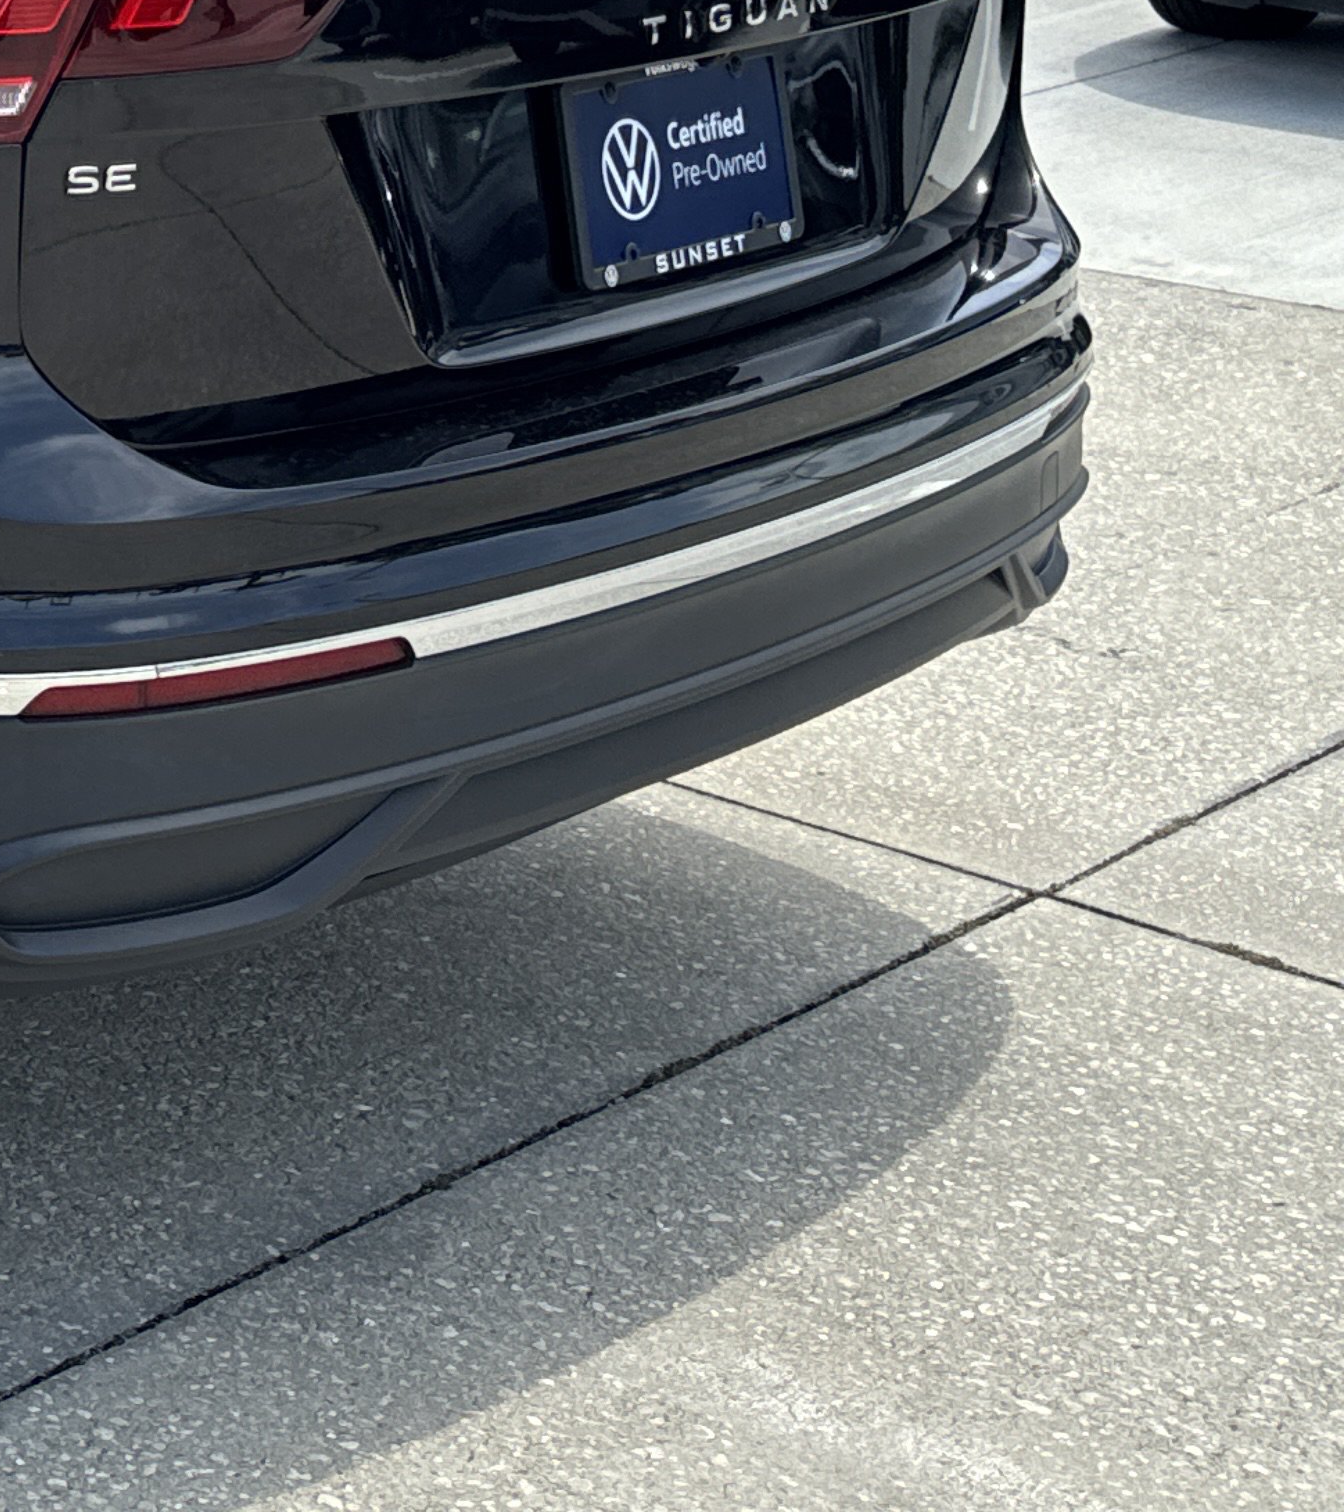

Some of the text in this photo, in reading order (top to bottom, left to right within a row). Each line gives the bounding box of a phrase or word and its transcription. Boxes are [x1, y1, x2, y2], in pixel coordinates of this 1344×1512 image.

[667, 107, 745, 150] Certified
[67, 163, 137, 195] SE
[602, 118, 661, 221] VW
[672, 143, 767, 189] Pre-Owned
[656, 234, 745, 273] SUNSET
